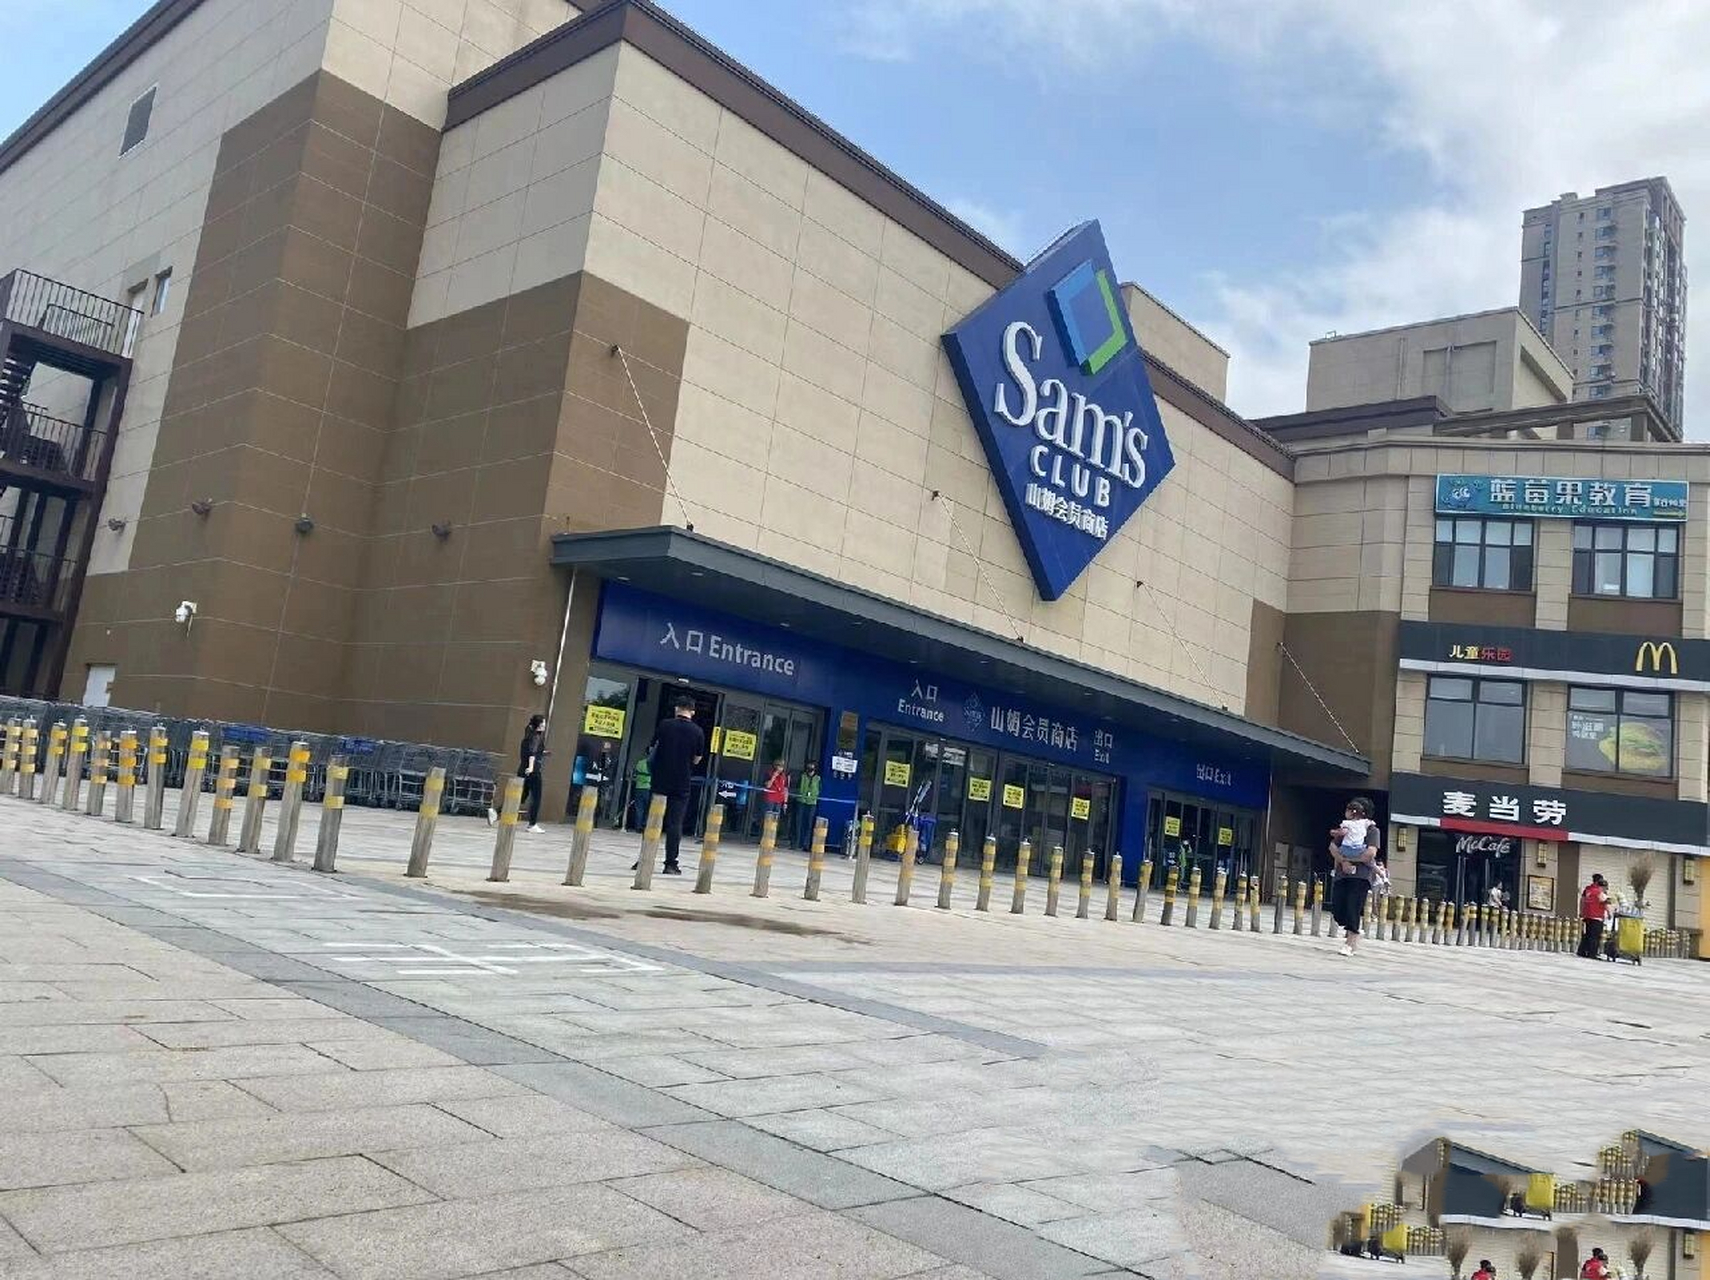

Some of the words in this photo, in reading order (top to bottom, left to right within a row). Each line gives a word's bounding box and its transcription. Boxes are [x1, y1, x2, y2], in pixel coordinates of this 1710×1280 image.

[994, 321, 1149, 488] Sam's
[1030, 445, 1111, 508] CLUB
[1490, 479, 1653, 508] 蓝莓果教育
[1025, 483, 1109, 540] 山姆会员商店
[659, 622, 703, 654] 入口
[709, 636, 795, 676] Entrance
[1449, 644, 1513, 662] 儿童乐园
[910, 679, 938, 700] 入口
[898, 699, 944, 723] Entrance
[991, 706, 1079, 752] 山姆会员商店
[1094, 729, 1113, 749] 出口
[1094, 749, 1110, 764] Exit
[1196, 763, 1213, 781] 出口
[1214, 768, 1232, 786] Exit
[1443, 791, 1566, 825] 麦当劳
